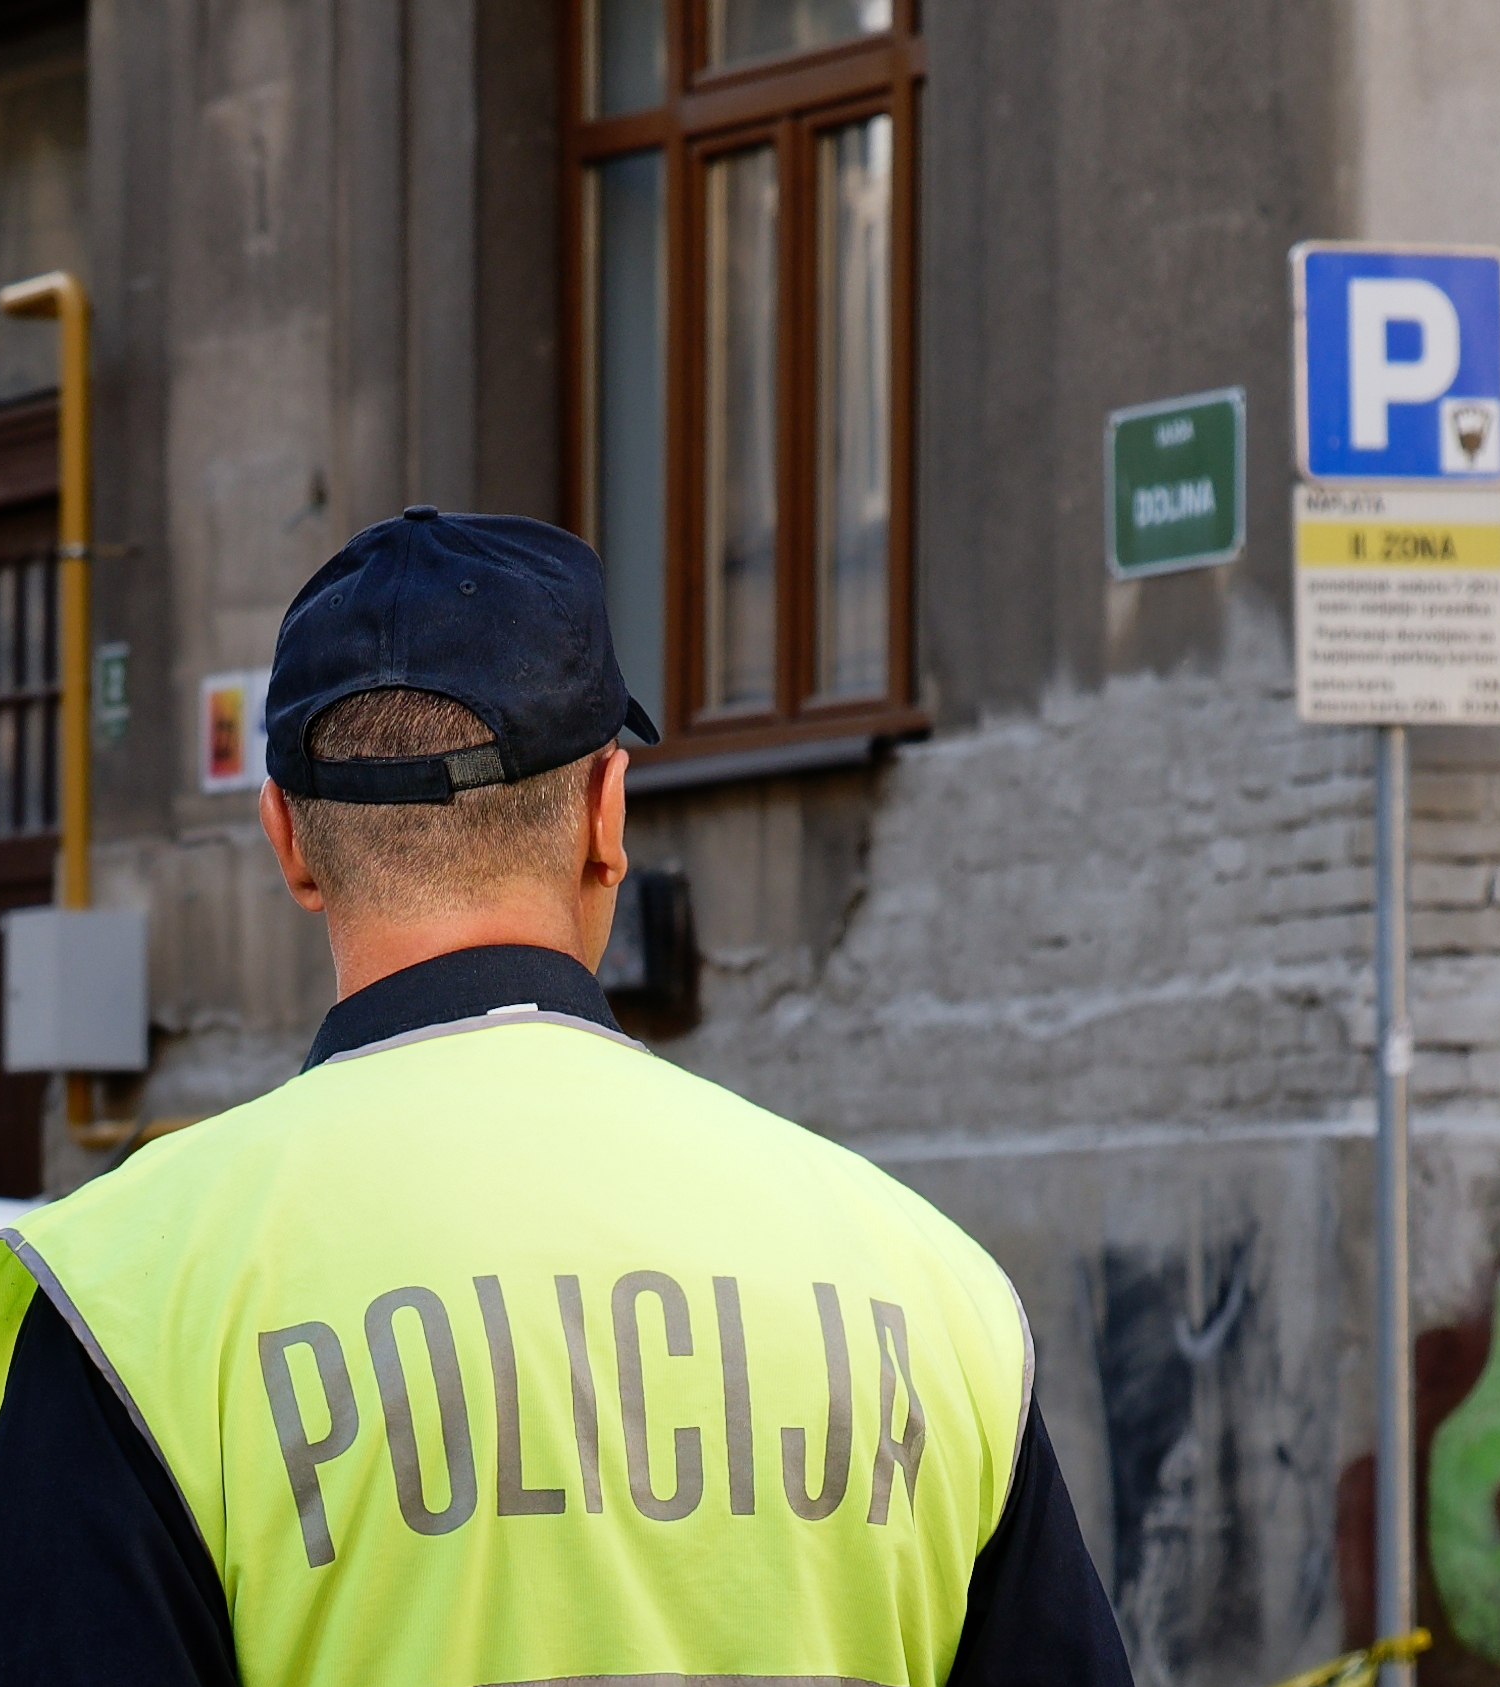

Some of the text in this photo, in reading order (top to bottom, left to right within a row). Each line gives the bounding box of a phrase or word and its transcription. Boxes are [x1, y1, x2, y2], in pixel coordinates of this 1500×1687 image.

[1347, 277, 1462, 452] P
[1381, 529, 1458, 563] ZONA
[258, 1269, 926, 1568] POLICIJA
